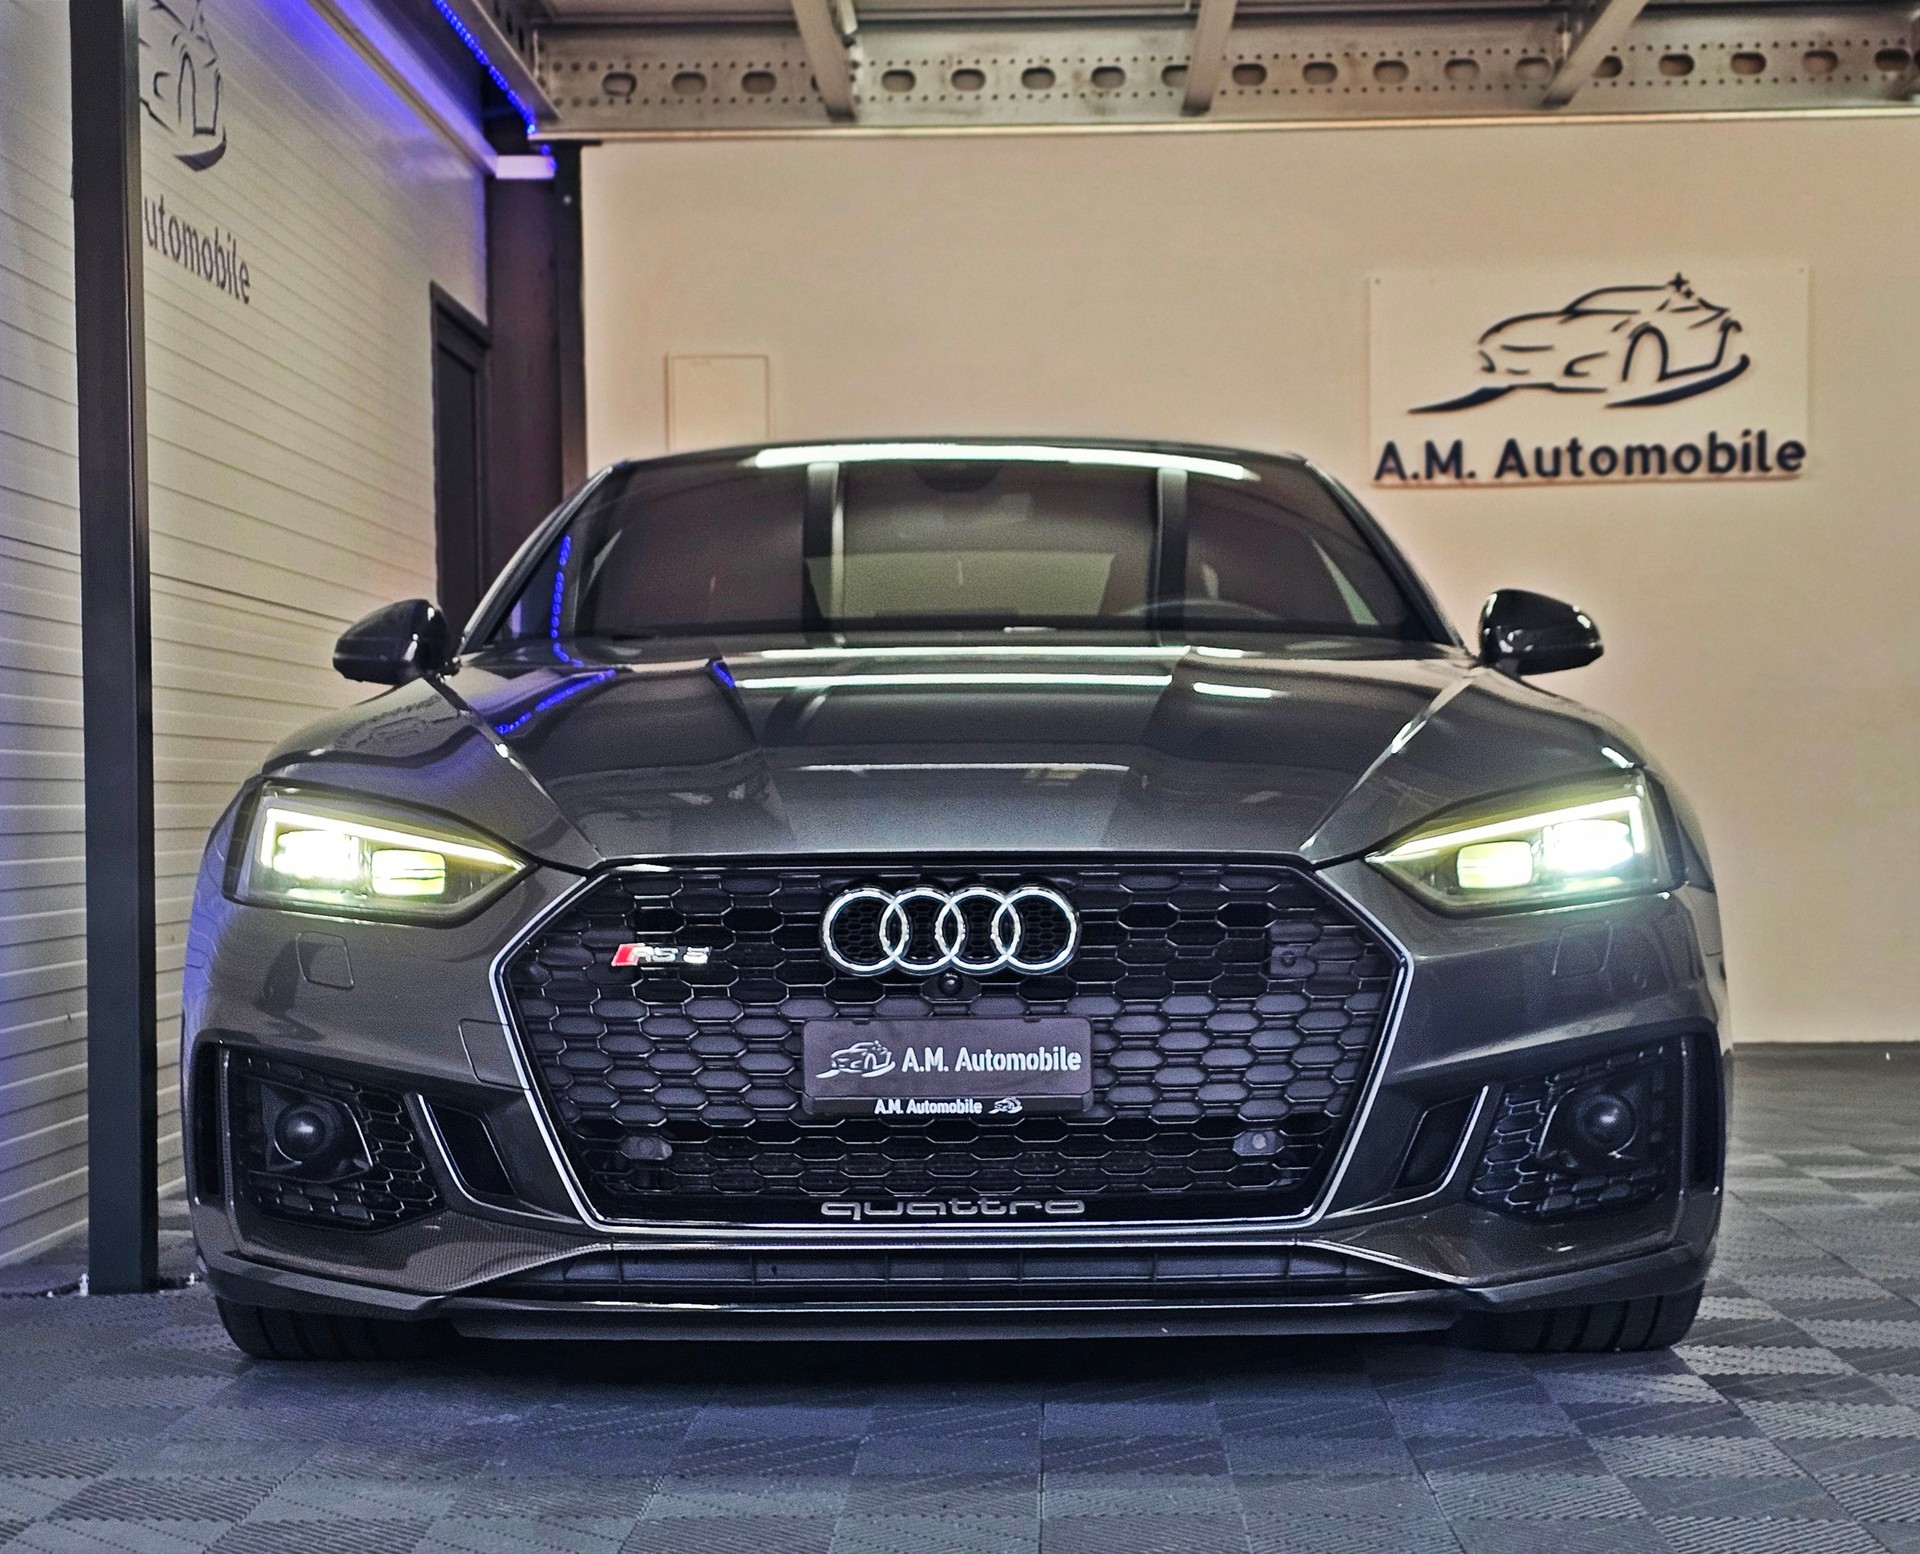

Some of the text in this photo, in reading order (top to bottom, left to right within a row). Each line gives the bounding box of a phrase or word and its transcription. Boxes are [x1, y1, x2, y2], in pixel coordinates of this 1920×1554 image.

[143, 193, 250, 304] utomobile
[1374, 429, 1807, 481] A.M. Automobile
[901, 1046, 1082, 1073] A.M. Automobile
[874, 1098, 983, 1115] A.M. Automobile
[820, 1199, 1085, 1221] quattro
